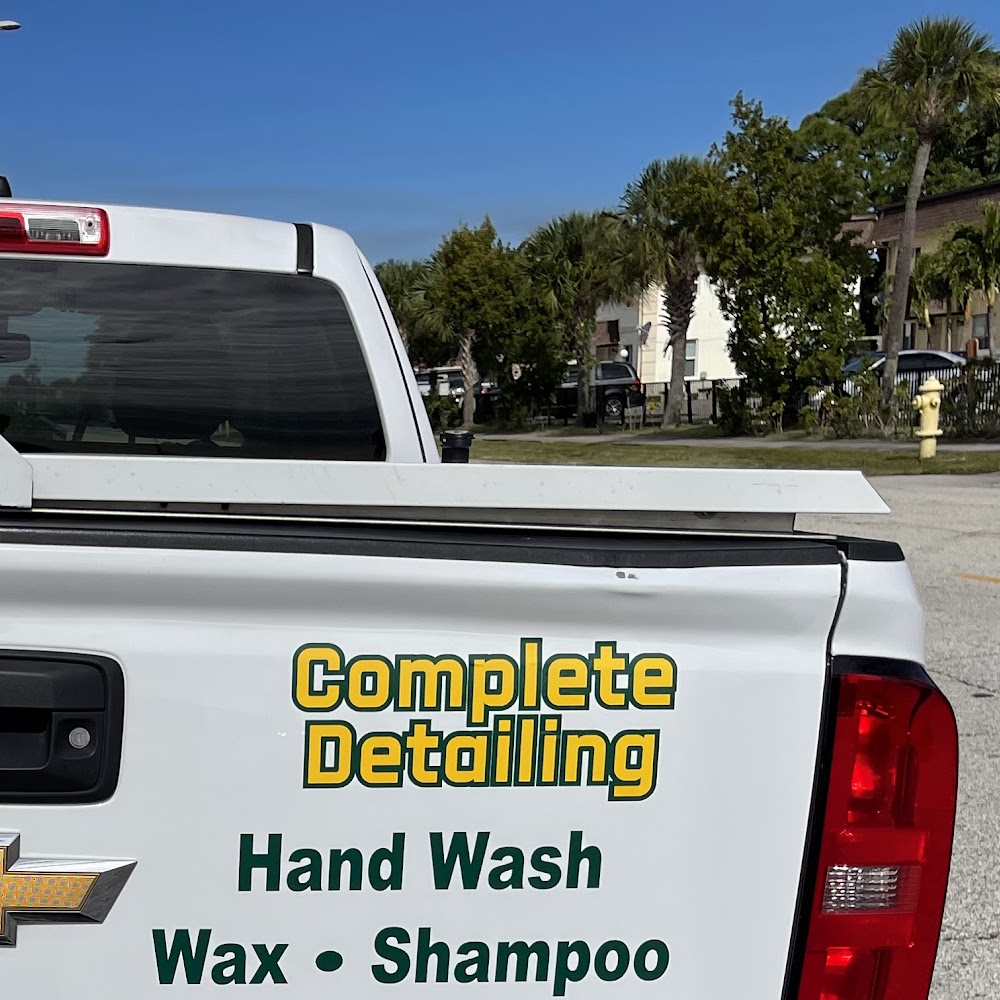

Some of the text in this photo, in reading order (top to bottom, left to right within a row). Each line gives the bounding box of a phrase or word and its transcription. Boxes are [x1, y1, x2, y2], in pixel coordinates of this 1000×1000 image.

[292, 638, 677, 727] Complete
[303, 715, 660, 801] Detailing
[238, 830, 602, 891] Hand Wash
[152, 927, 670, 996] Wax Shampoo
